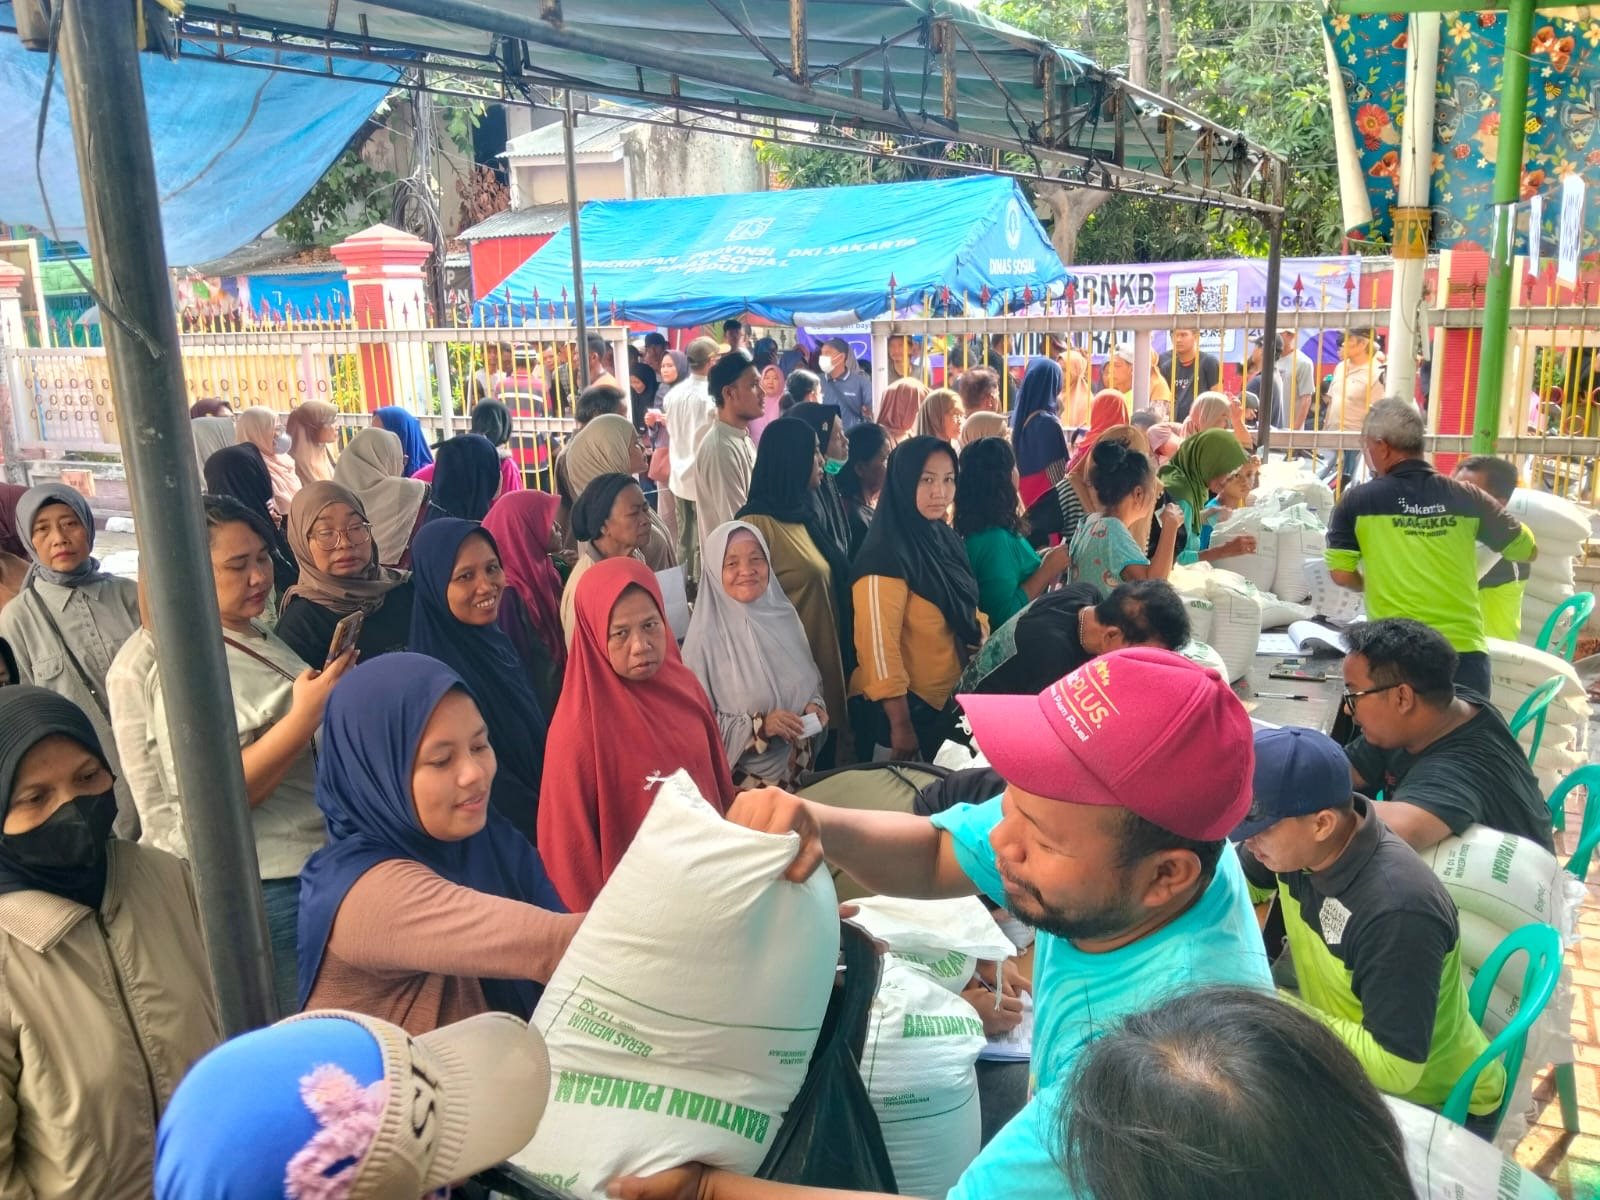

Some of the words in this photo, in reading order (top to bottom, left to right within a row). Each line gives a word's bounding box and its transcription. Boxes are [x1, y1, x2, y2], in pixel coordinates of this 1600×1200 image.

[788, 247, 822, 257] DKI
[826, 237, 918, 255] JAKARTA
[989, 258, 1012, 275] DINAS
[1013, 258, 1037, 275] SOSIAL
[1250, 296, 1316, 308] HIGGA
[567, 1012, 617, 1042] MEDIUM
[902, 1014, 967, 1038] BANTUAN
[613, 1032, 653, 1058] BERAS
[554, 1070, 666, 1113] PANGAN
[666, 1087, 770, 1144] BANTUAN
